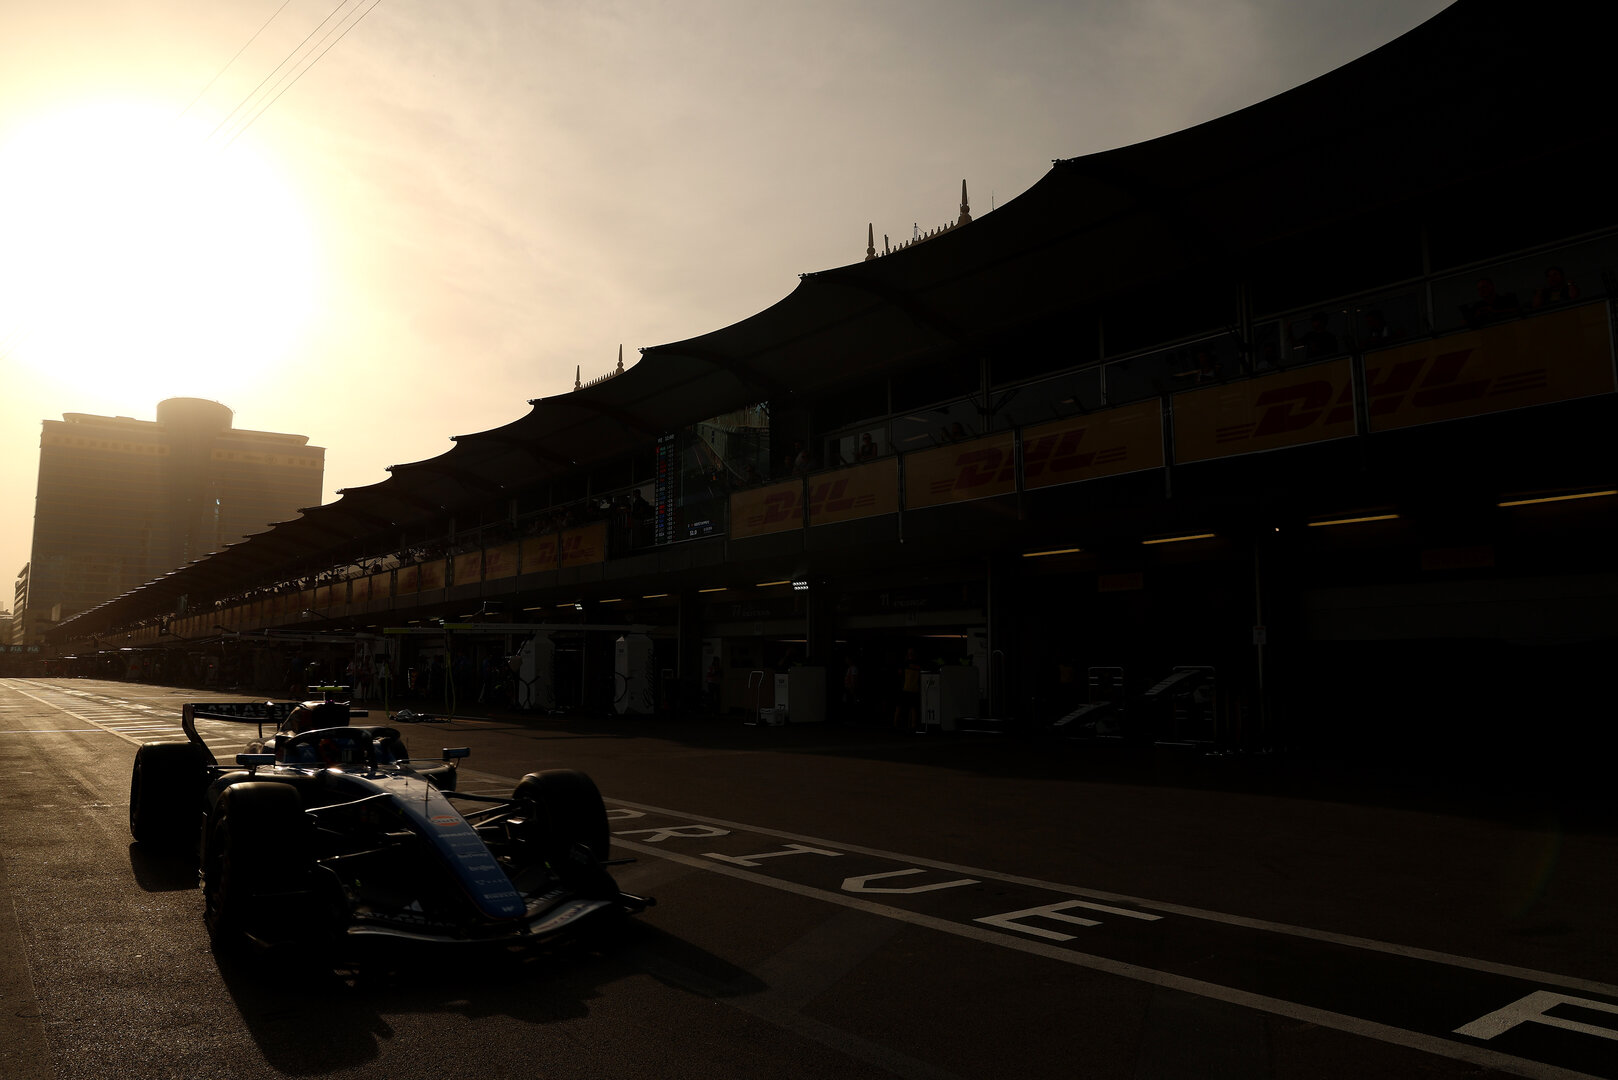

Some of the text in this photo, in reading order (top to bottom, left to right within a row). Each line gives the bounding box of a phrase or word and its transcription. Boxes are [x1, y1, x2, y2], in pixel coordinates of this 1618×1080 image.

[1253, 348, 1492, 437] DHL
[953, 428, 1098, 489] DHL
[763, 478, 855, 524] DHL
